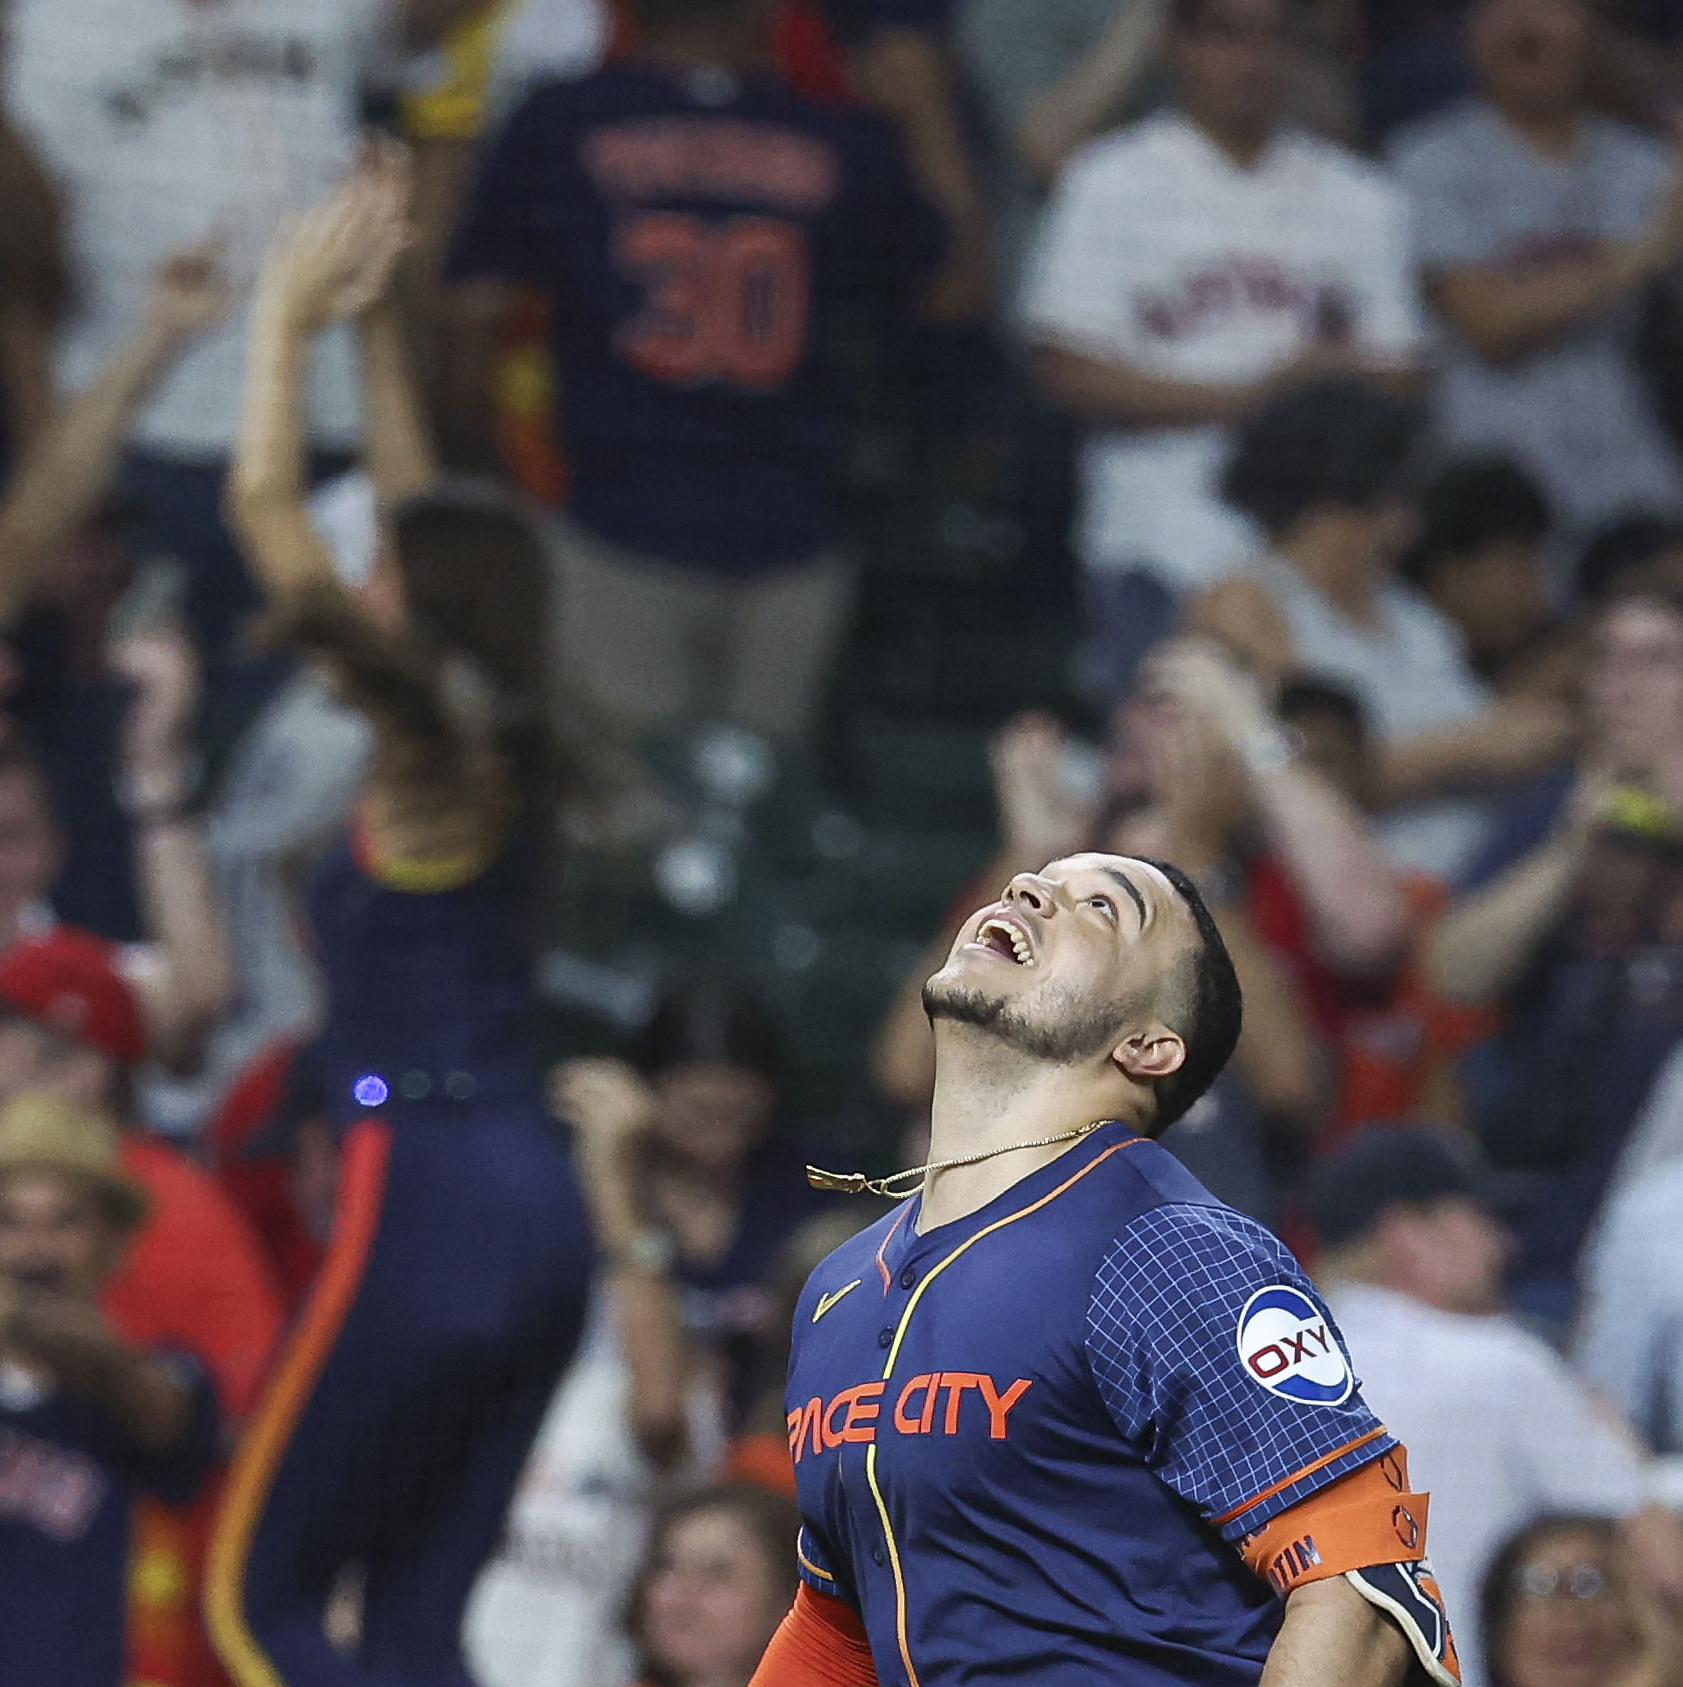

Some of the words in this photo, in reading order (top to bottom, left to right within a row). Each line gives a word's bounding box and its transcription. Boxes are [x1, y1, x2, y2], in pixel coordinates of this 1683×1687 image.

[617, 210, 811, 390] 30
[1248, 1324, 1330, 1378] OXY
[786, 1381, 885, 1464] PACE
[893, 1370, 1033, 1441] CITY
